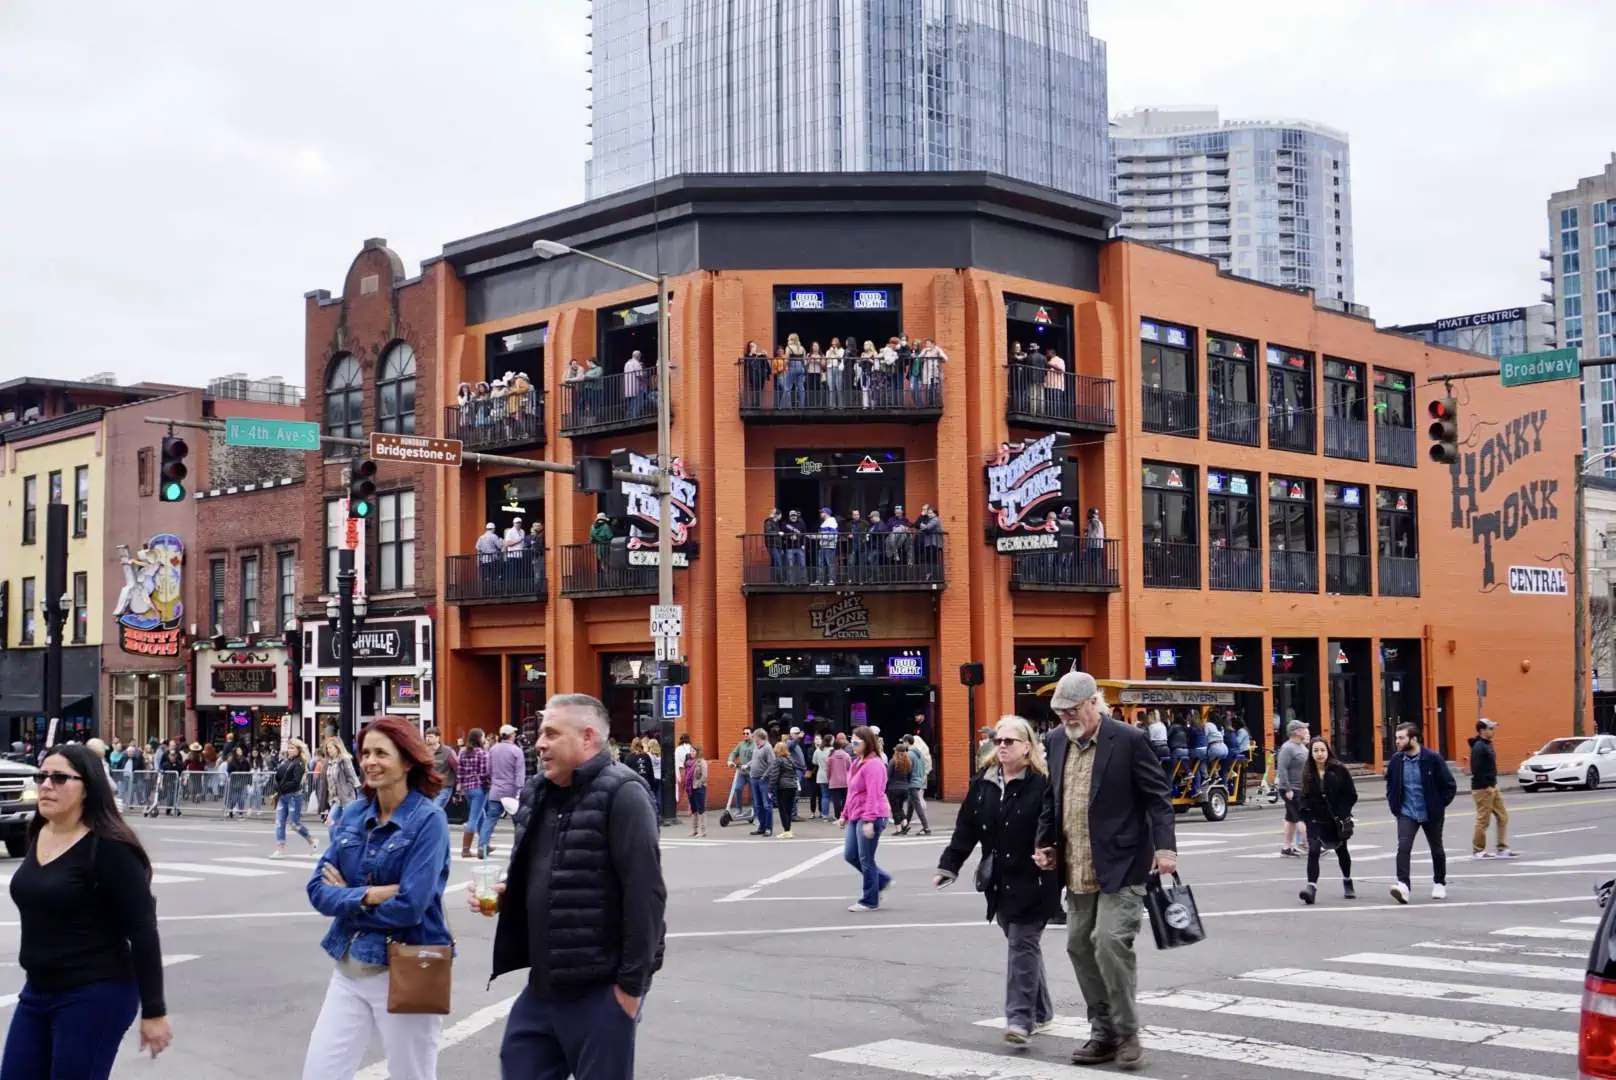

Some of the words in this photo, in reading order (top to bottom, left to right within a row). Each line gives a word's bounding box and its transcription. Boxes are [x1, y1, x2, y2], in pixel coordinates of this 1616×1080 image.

[1438, 316, 1470, 329] HYATT
[1473, 309, 1520, 325] CENTRIC
[1505, 358, 1573, 378] Broadway
[376, 444, 444, 461] Bridgestone
[445, 452, 456, 461] Dr
[988, 434, 1056, 501] HONKY
[1449, 409, 1547, 529] HONKY
[629, 452, 697, 507] HKY
[1001, 466, 1061, 526] TONK
[997, 534, 1058, 551] CENTRAL
[1472, 480, 1558, 588] TONK
[629, 551, 689, 566] CENTAL
[1510, 568, 1566, 592] CENTRAL
[811, 596, 862, 627] HONKY
[652, 621, 664, 632] OK
[821, 609, 868, 637] TONK
[837, 630, 868, 638] CENTRAL
[125, 640, 178, 656] BOOTS
[889, 666, 921, 675] LIGHT
[894, 658, 917, 667] BUD
[246, 670, 266, 683] CITY
[1142, 692, 1176, 702] PEDAL
[1181, 693, 1218, 702] TAVERN
